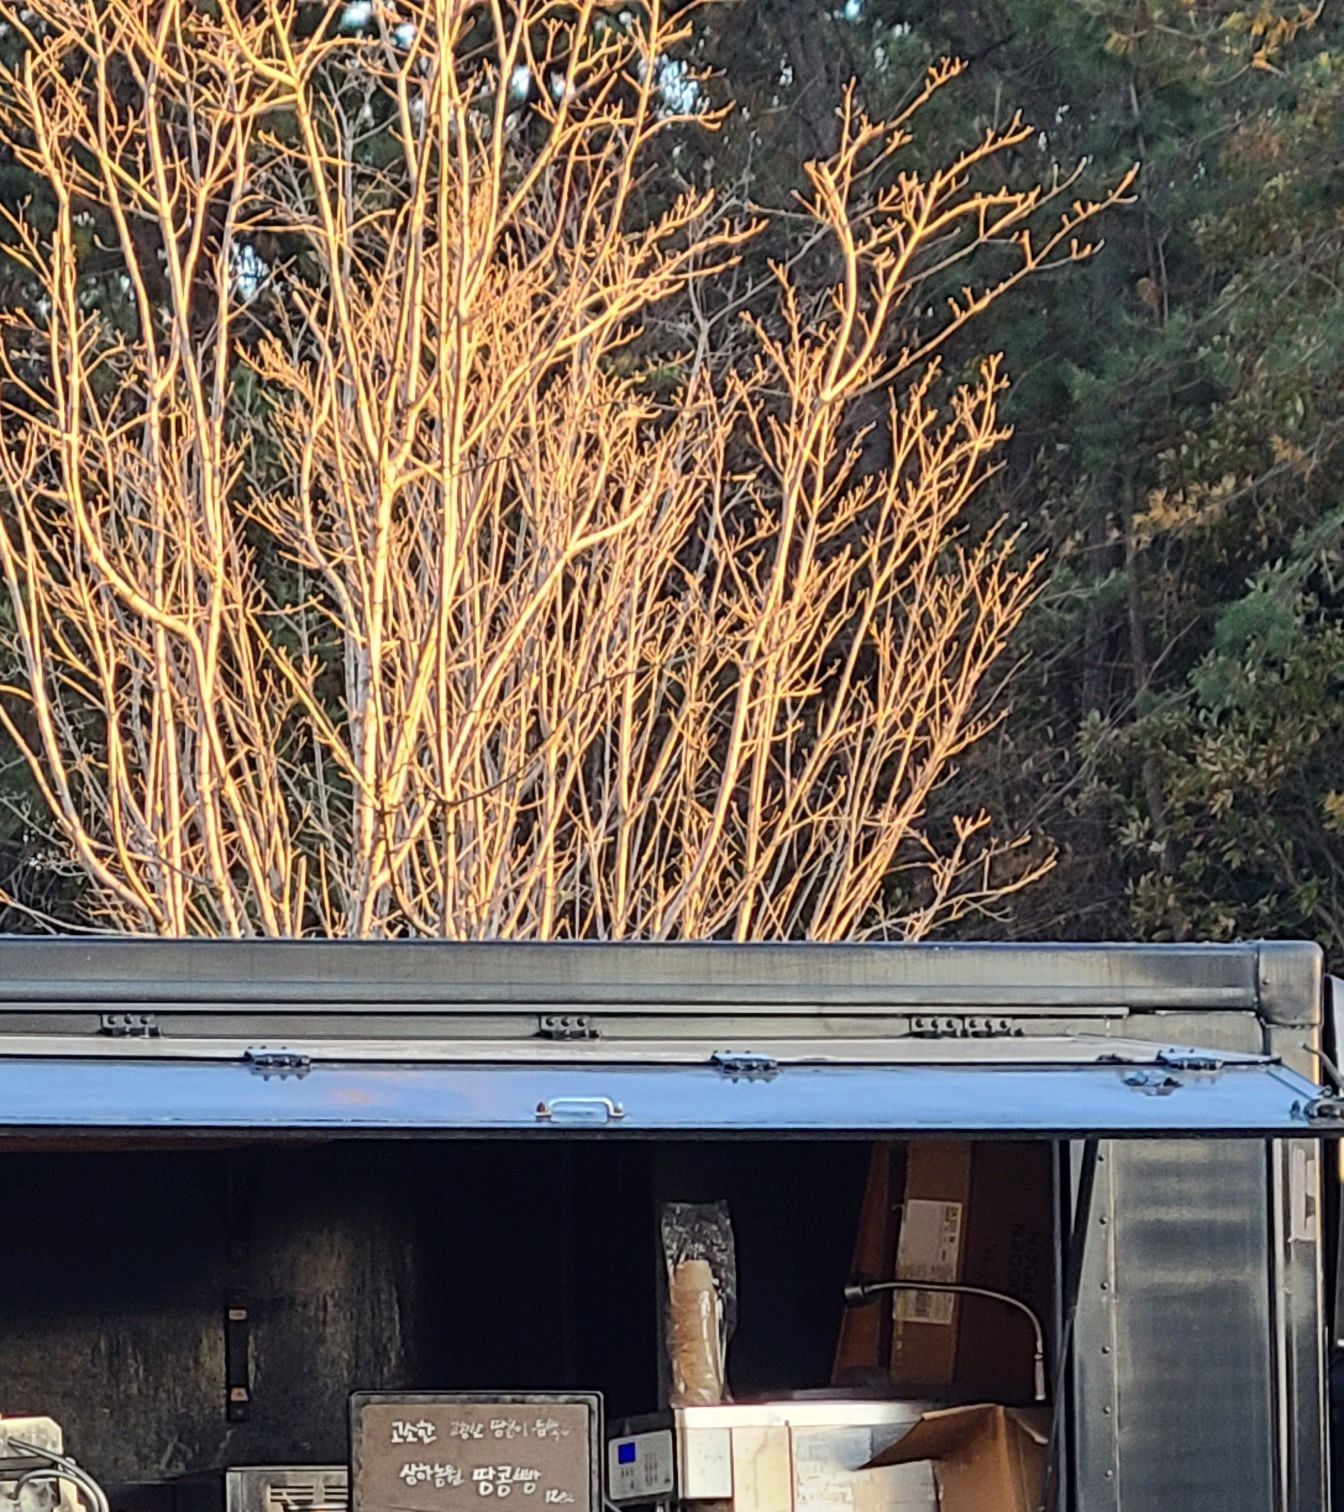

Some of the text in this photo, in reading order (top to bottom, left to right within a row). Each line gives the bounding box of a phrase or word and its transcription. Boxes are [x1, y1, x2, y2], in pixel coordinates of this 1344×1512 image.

[390, 1420, 437, 1444] 고소한
[399, 1462, 464, 1488] 상하농원
[472, 1465, 542, 1497] 땅콩빵
